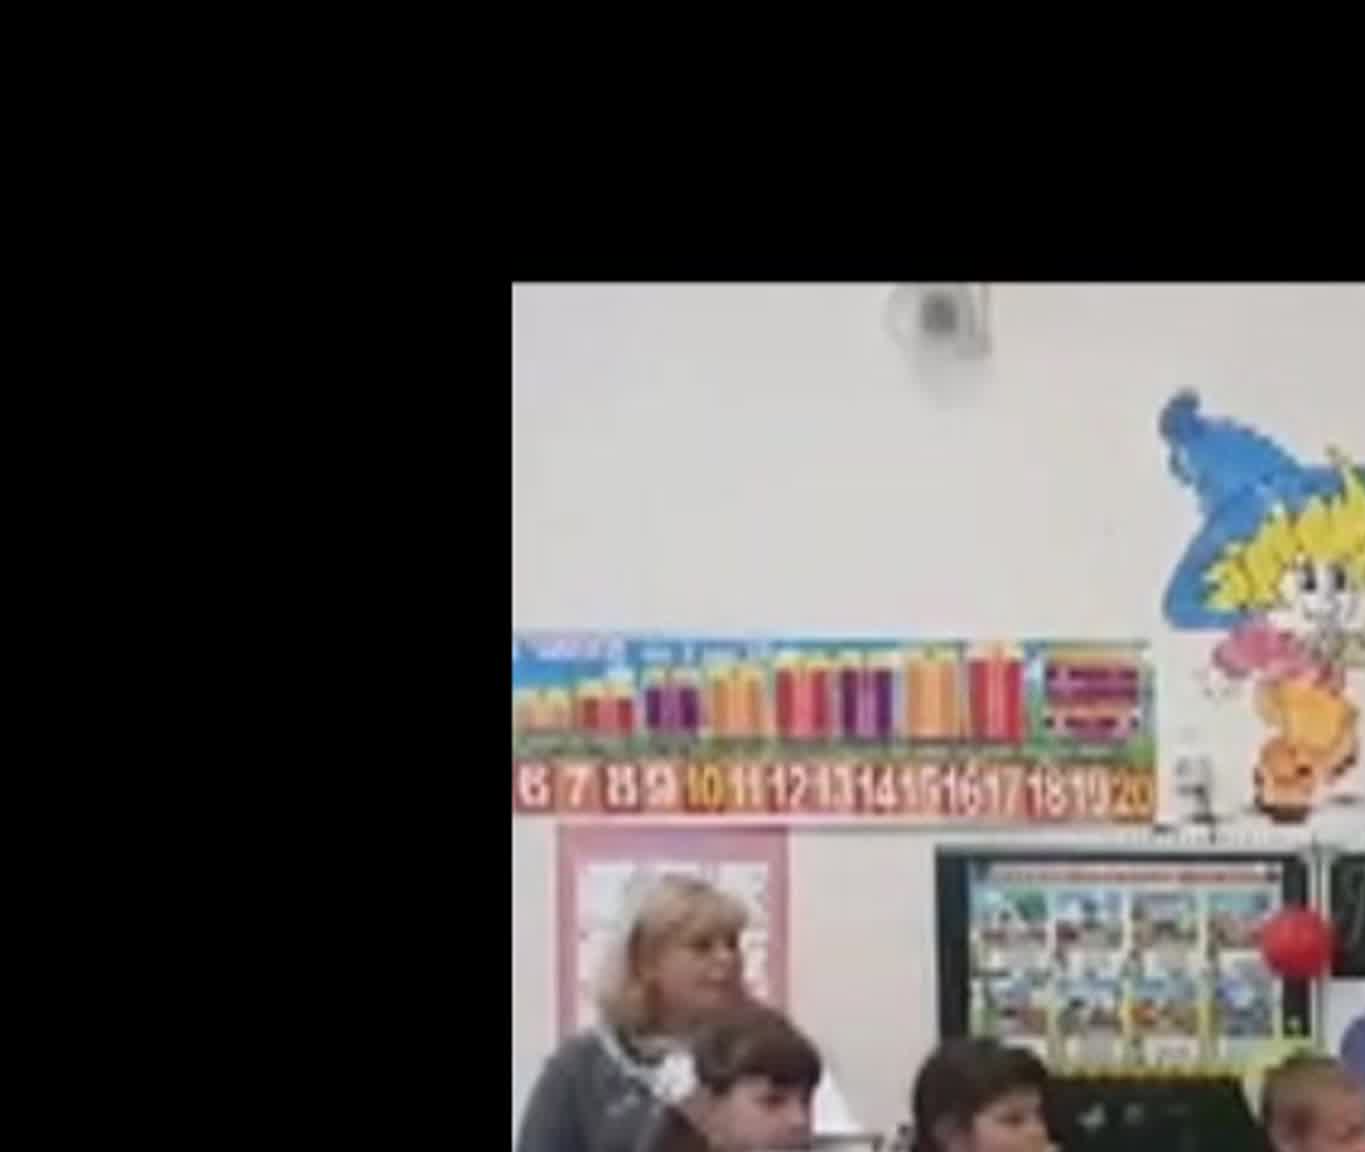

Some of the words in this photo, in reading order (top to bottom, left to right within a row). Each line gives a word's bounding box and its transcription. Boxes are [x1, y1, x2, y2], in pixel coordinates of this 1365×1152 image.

[519, 765, 551, 807] 6
[563, 765, 591, 807] 7
[606, 765, 638, 807] 8
[646, 765, 678, 807] 9
[687, 765, 723, 808] 10
[728, 765, 761, 808] 11
[767, 765, 808, 809] 12
[856, 766, 898, 811] 14
[944, 767, 980, 815] 16
[983, 767, 1024, 816] 17
[1027, 767, 1069, 816] 18
[1111, 768, 1151, 816] 20
